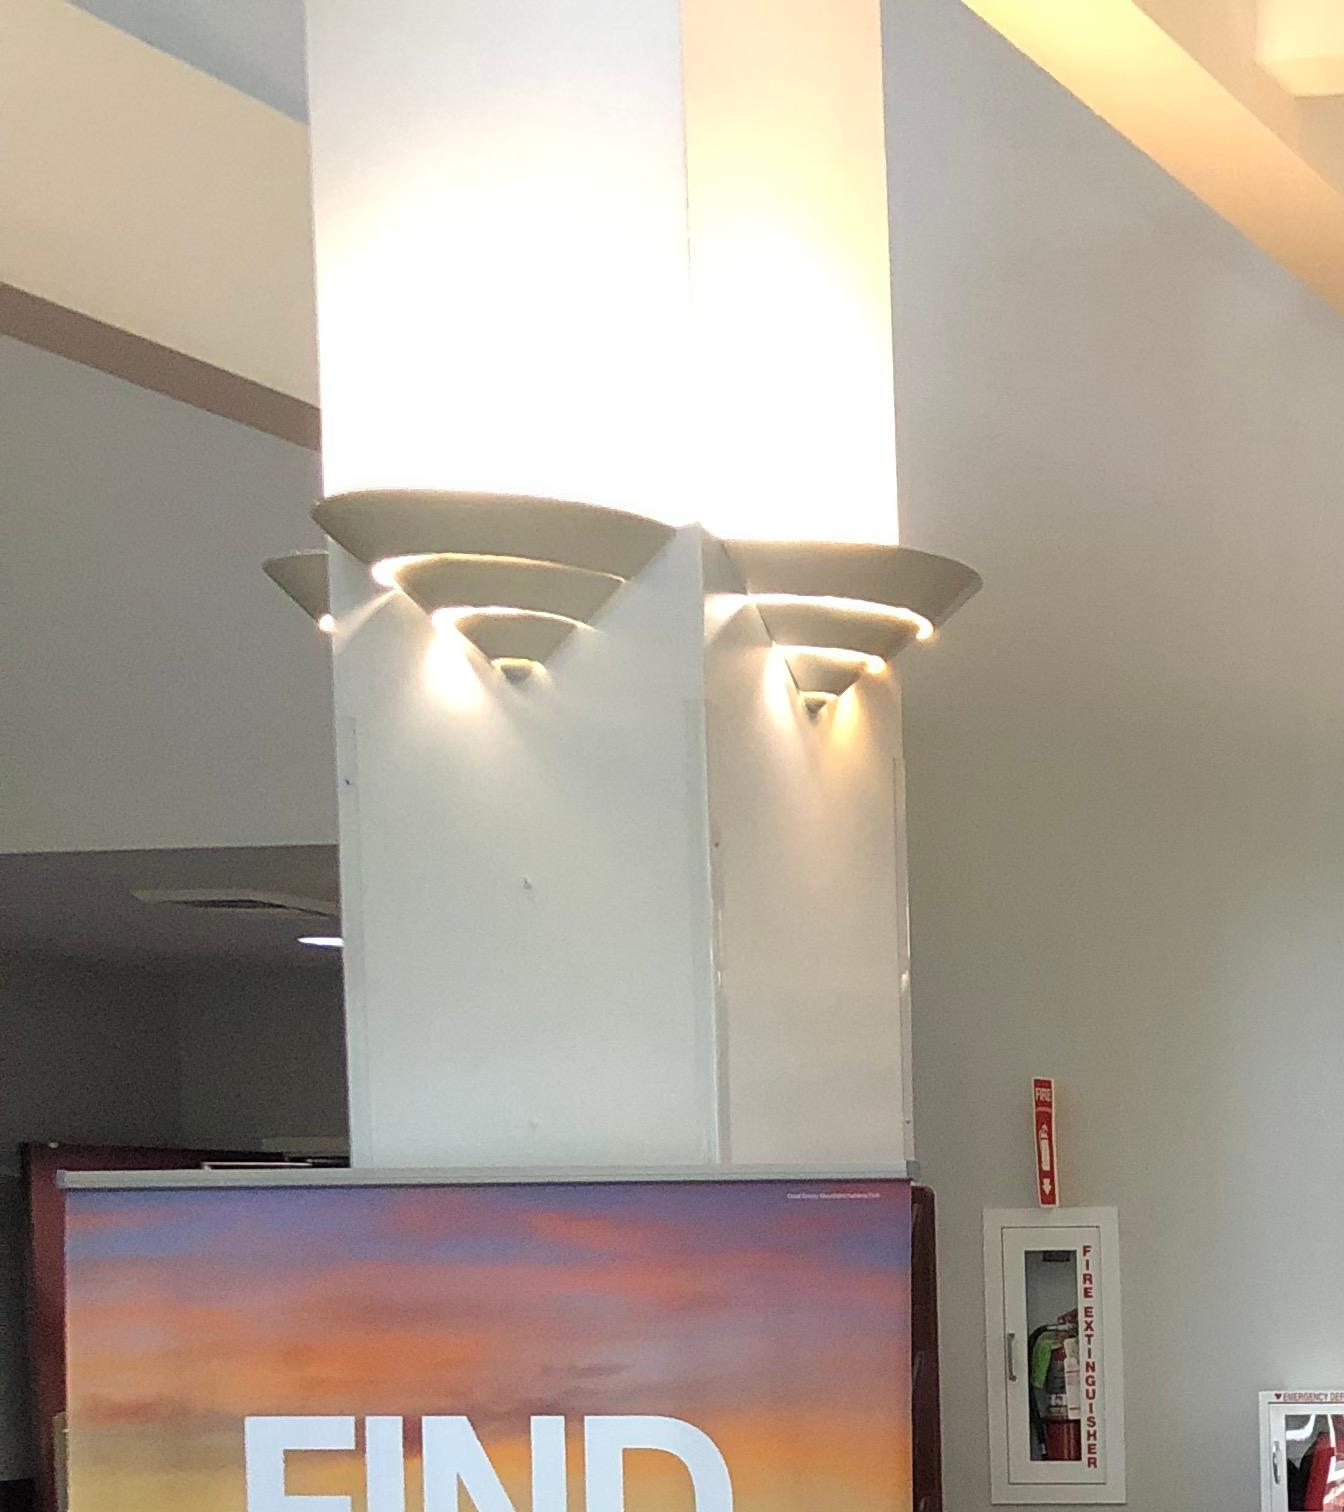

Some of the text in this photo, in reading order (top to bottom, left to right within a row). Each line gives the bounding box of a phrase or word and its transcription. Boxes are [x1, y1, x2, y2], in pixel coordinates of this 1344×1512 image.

[1036, 1087, 1052, 1102] FIRE
[1082, 1245, 1098, 1469] FIRE EXTINGUISHER
[1283, 1392, 1329, 1402] EMERGENCY
